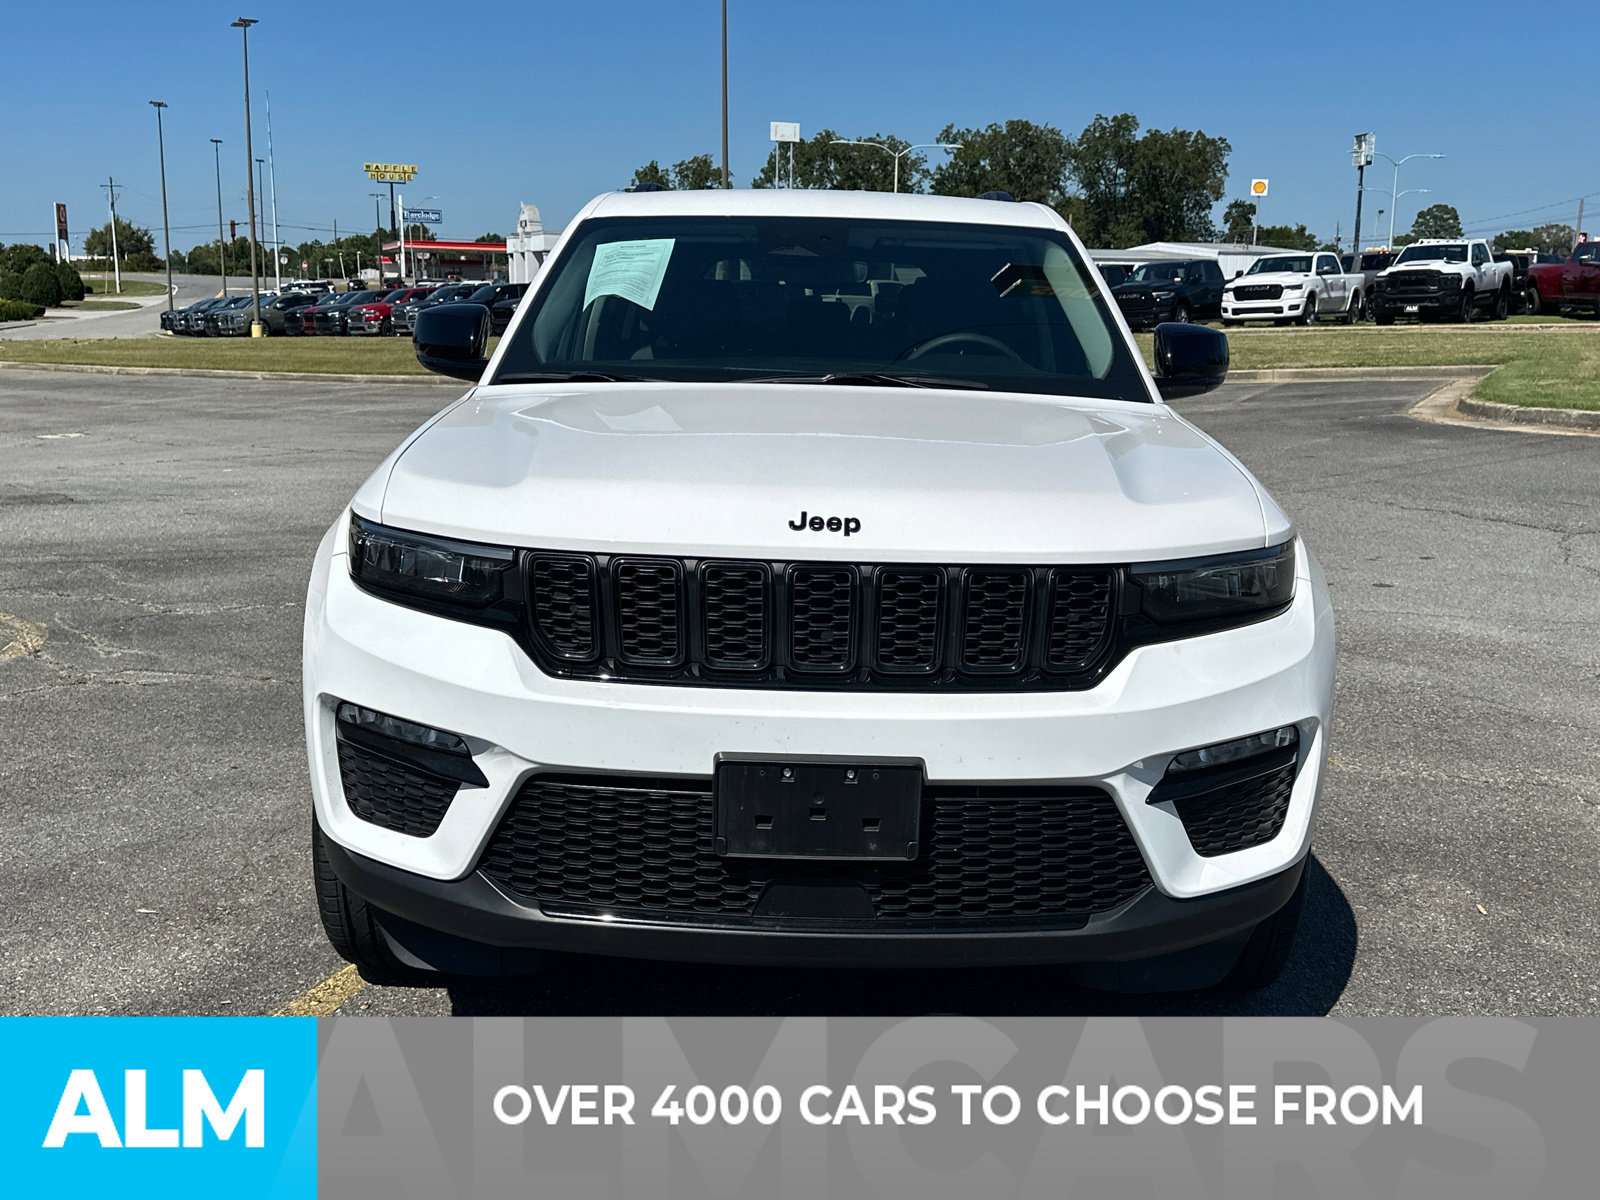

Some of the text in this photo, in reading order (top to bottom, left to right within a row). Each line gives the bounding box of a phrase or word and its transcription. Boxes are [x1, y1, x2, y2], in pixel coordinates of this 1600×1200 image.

[364, 163, 417, 173] WAFFLE
[369, 172, 413, 181] HOUSE
[788, 510, 861, 536] Jeep
